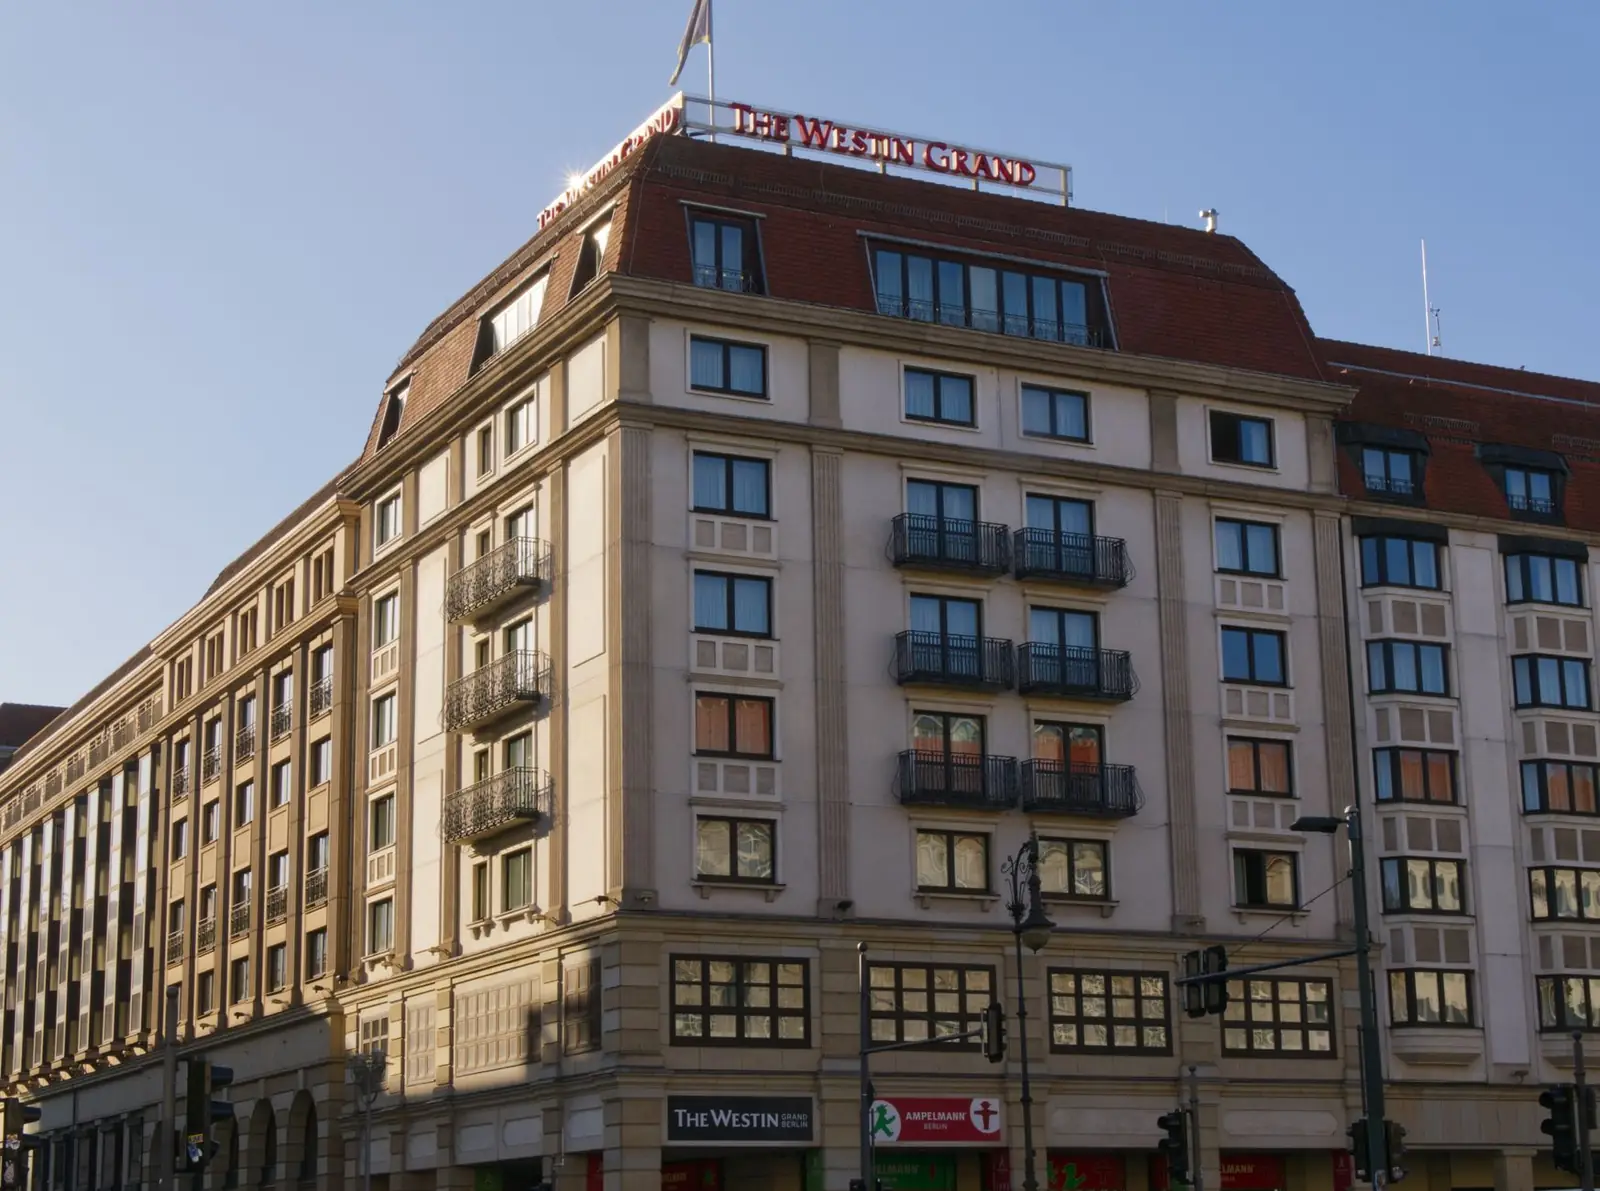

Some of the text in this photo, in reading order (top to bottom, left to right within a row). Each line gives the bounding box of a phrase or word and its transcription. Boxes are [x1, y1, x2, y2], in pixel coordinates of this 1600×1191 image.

[731, 102, 1036, 186] THE WESTIN GRAND
[674, 1108, 779, 1128] THE WESTIN
[905, 1111, 966, 1121] AMPELMANN
[923, 1122, 948, 1130] BERLIN
